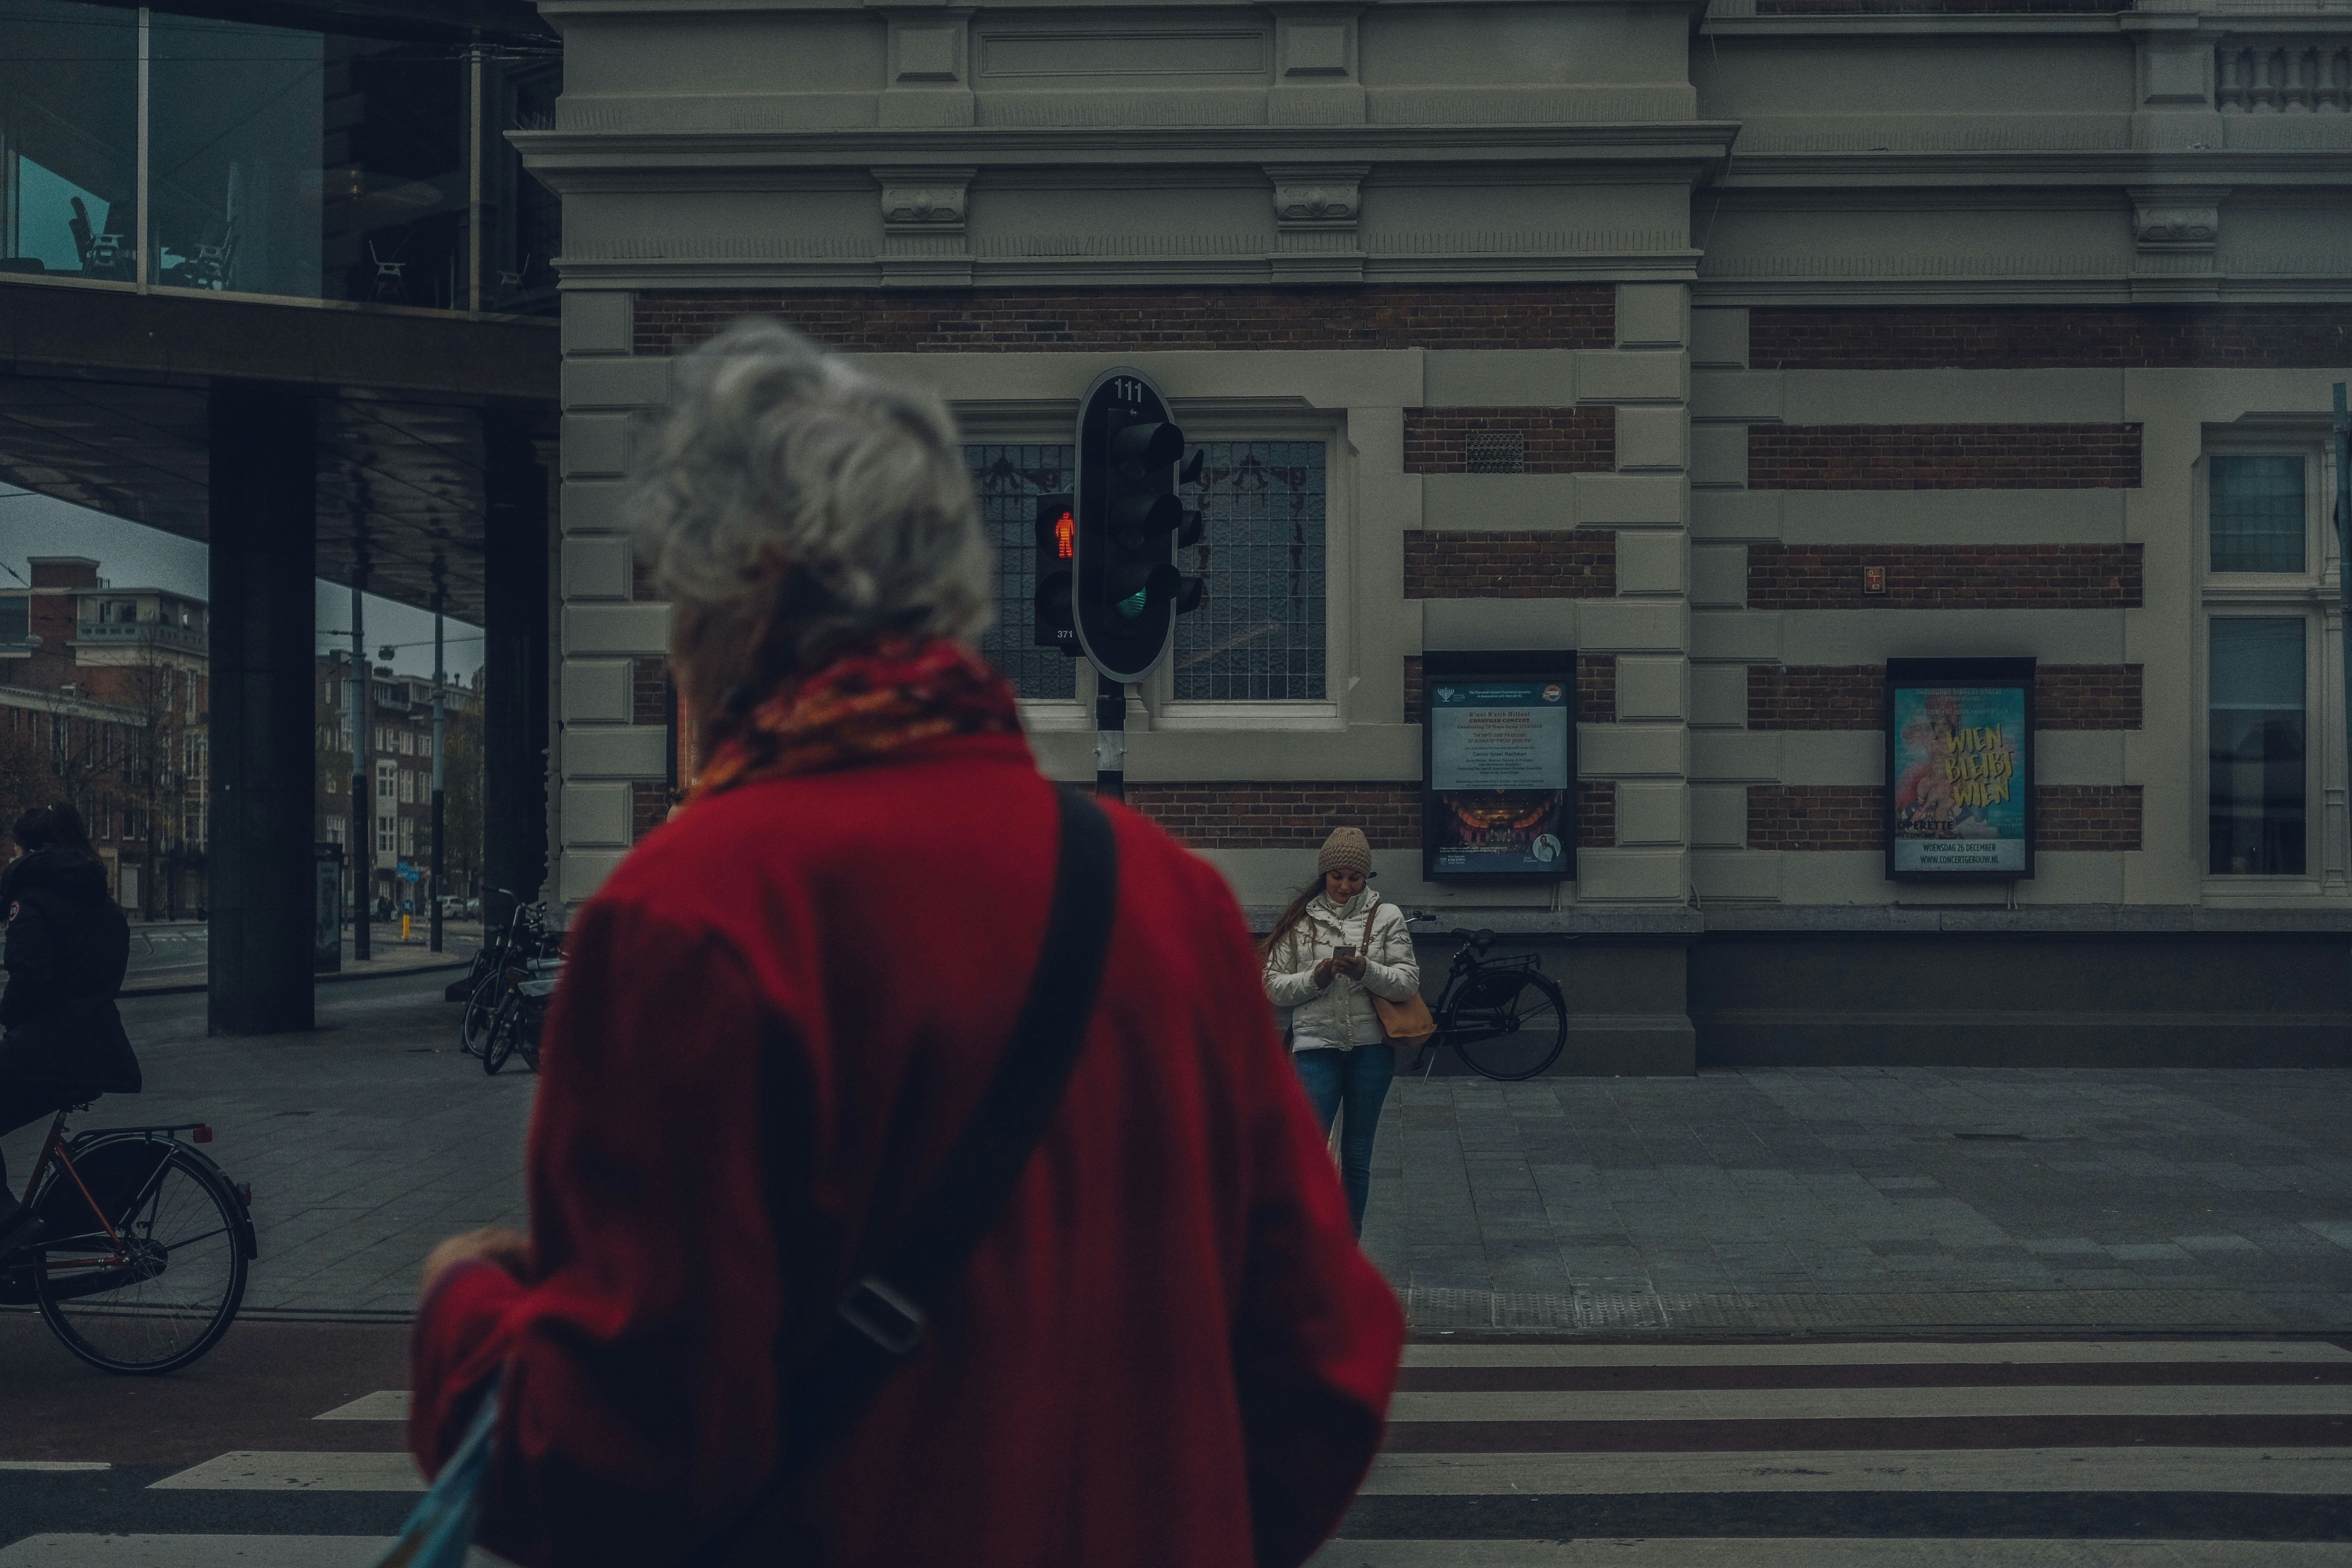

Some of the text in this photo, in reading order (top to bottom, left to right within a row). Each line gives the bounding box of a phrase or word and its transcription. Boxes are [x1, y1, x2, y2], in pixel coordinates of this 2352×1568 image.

[1114, 379, 1141, 403] 111
[1946, 723, 2002, 754] WIEN
[1945, 751, 2014, 784] BLEIBT
[1954, 778, 2009, 808] WIEN
[1897, 821, 1954, 830] OPERETTE
[1921, 855, 1999, 864] WWW.CONCERTGEBOUW.NL
[1923, 844, 1956, 852] WOENSDAG
[1966, 843, 1996, 851] DECEMBER
